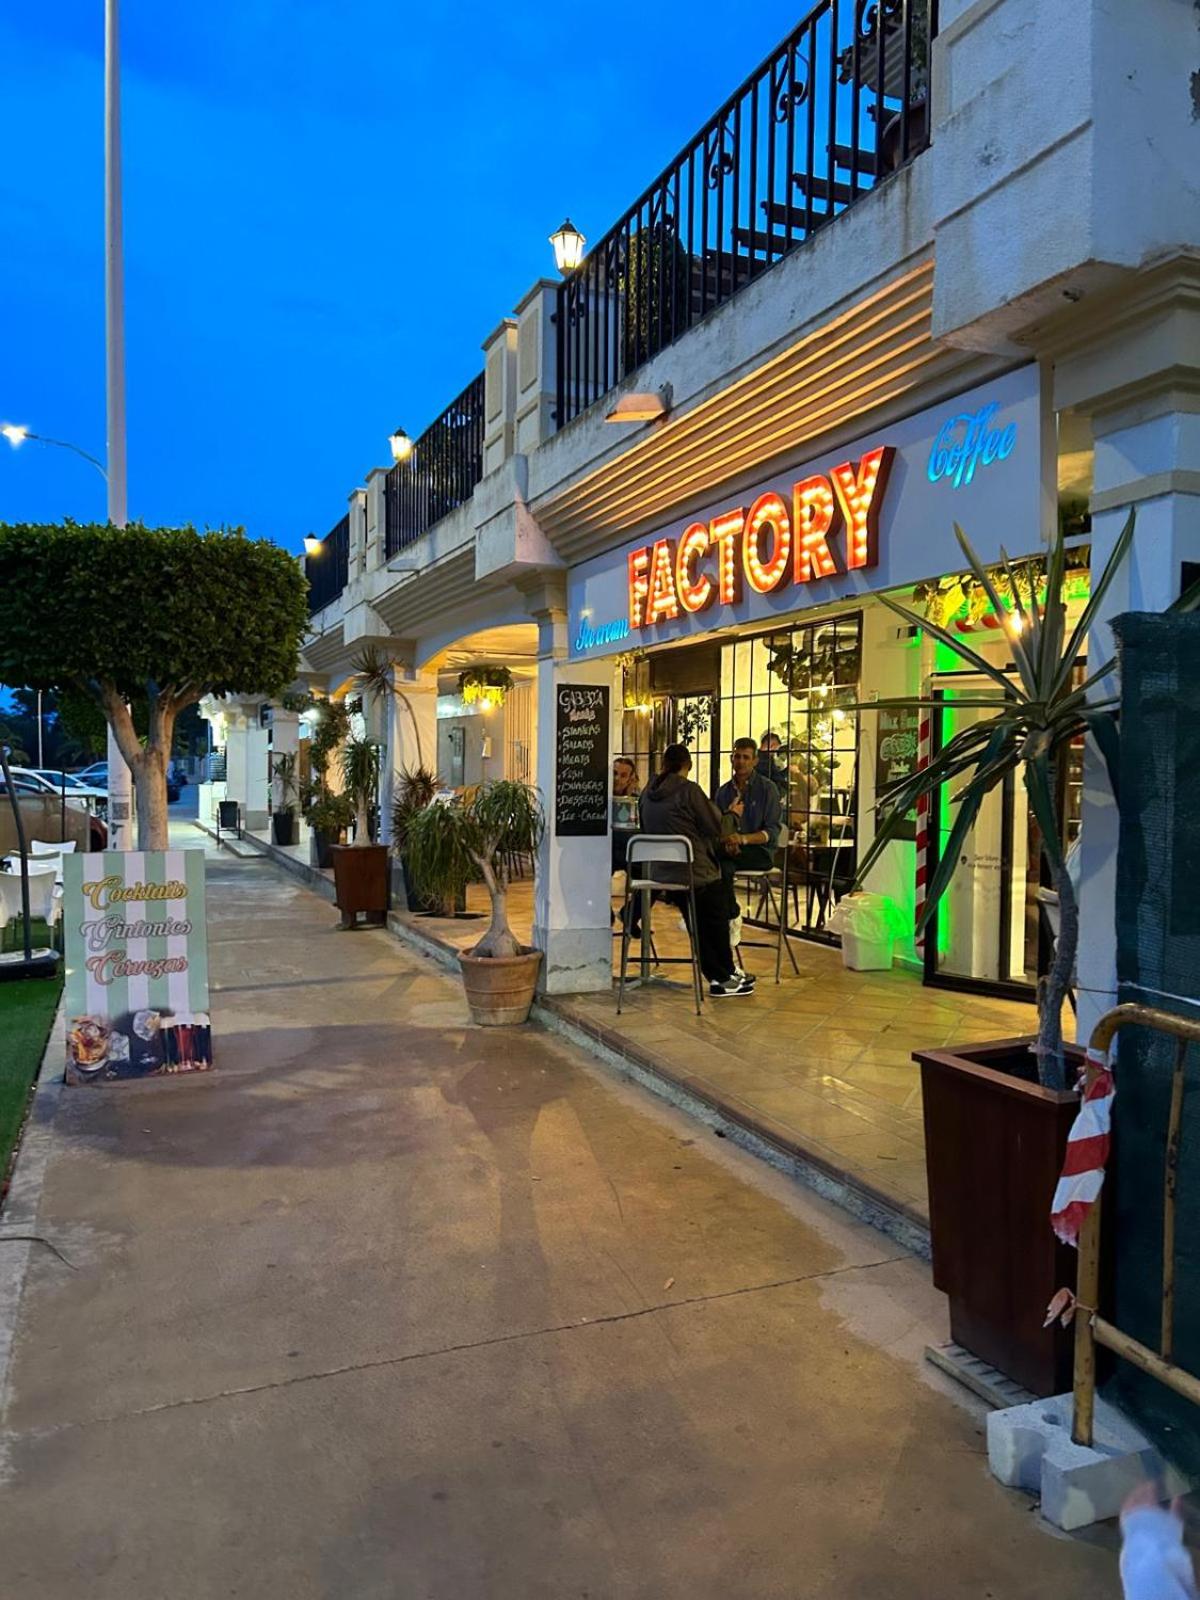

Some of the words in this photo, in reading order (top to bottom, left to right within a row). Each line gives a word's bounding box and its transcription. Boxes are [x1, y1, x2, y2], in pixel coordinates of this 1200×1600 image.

[927, 400, 1018, 489] Coffee
[628, 446, 895, 629] FACTORY
[81, 875, 188, 911] Cocktails
[79, 913, 193, 952] Gintonics
[85, 949, 189, 986] Cervezas
